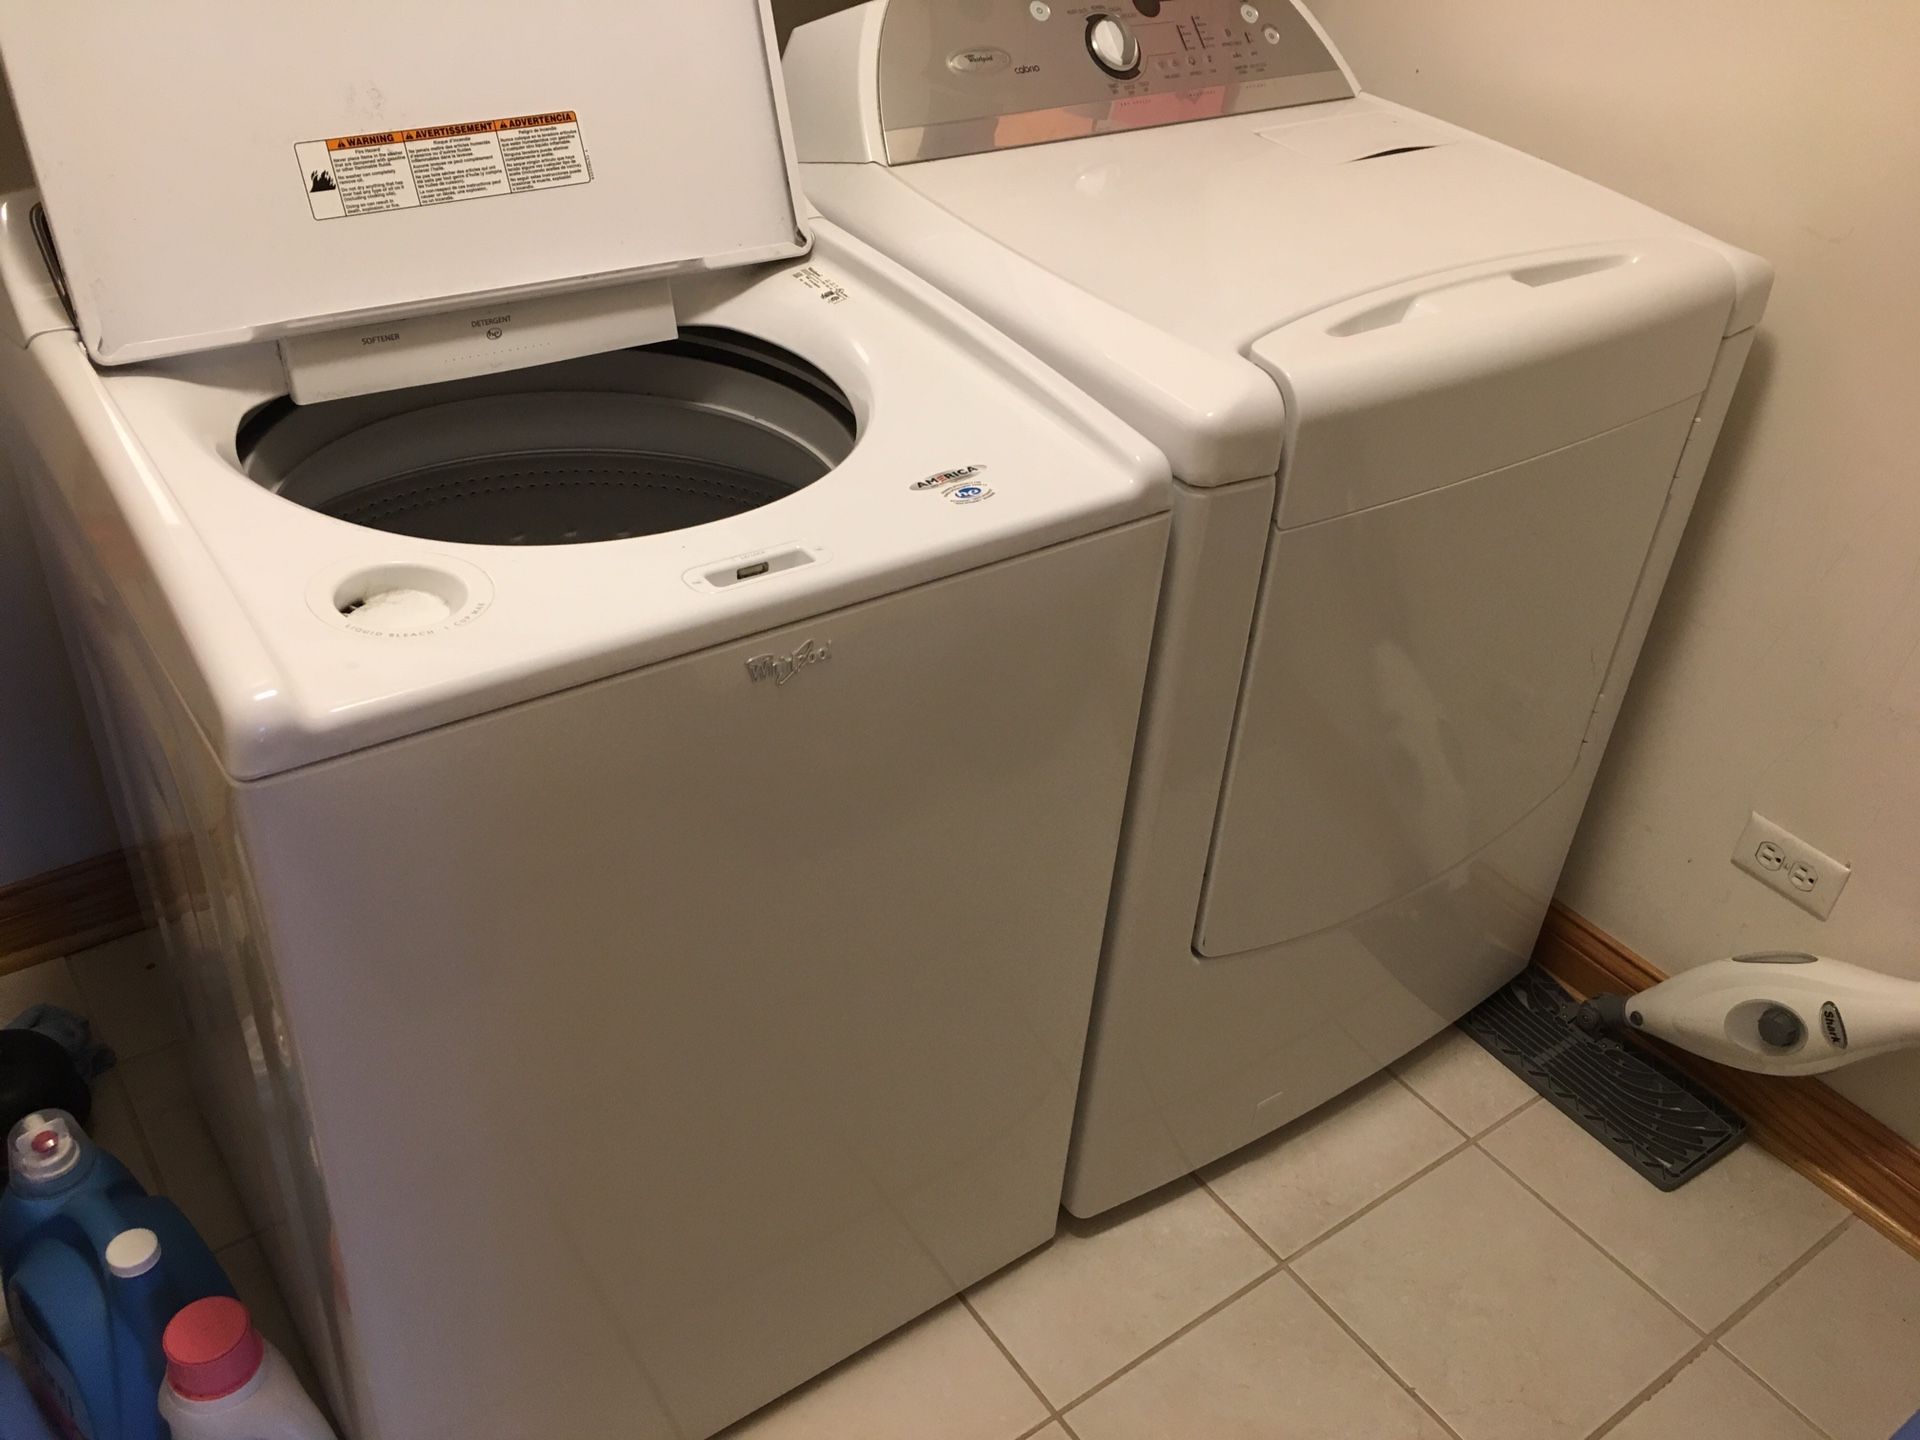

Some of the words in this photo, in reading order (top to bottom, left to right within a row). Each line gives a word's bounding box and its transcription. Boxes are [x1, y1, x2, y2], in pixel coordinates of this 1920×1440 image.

[509, 113, 572, 128] ADVERTENCIA
[415, 122, 493, 139] AVERTISSEMENT
[346, 134, 394, 146] WARNING
[471, 315, 511, 328] DETERGENT
[361, 333, 400, 346] SOFTENER
[917, 466, 978, 488] AMERICA
[1824, 1010, 1841, 1044] Shark
